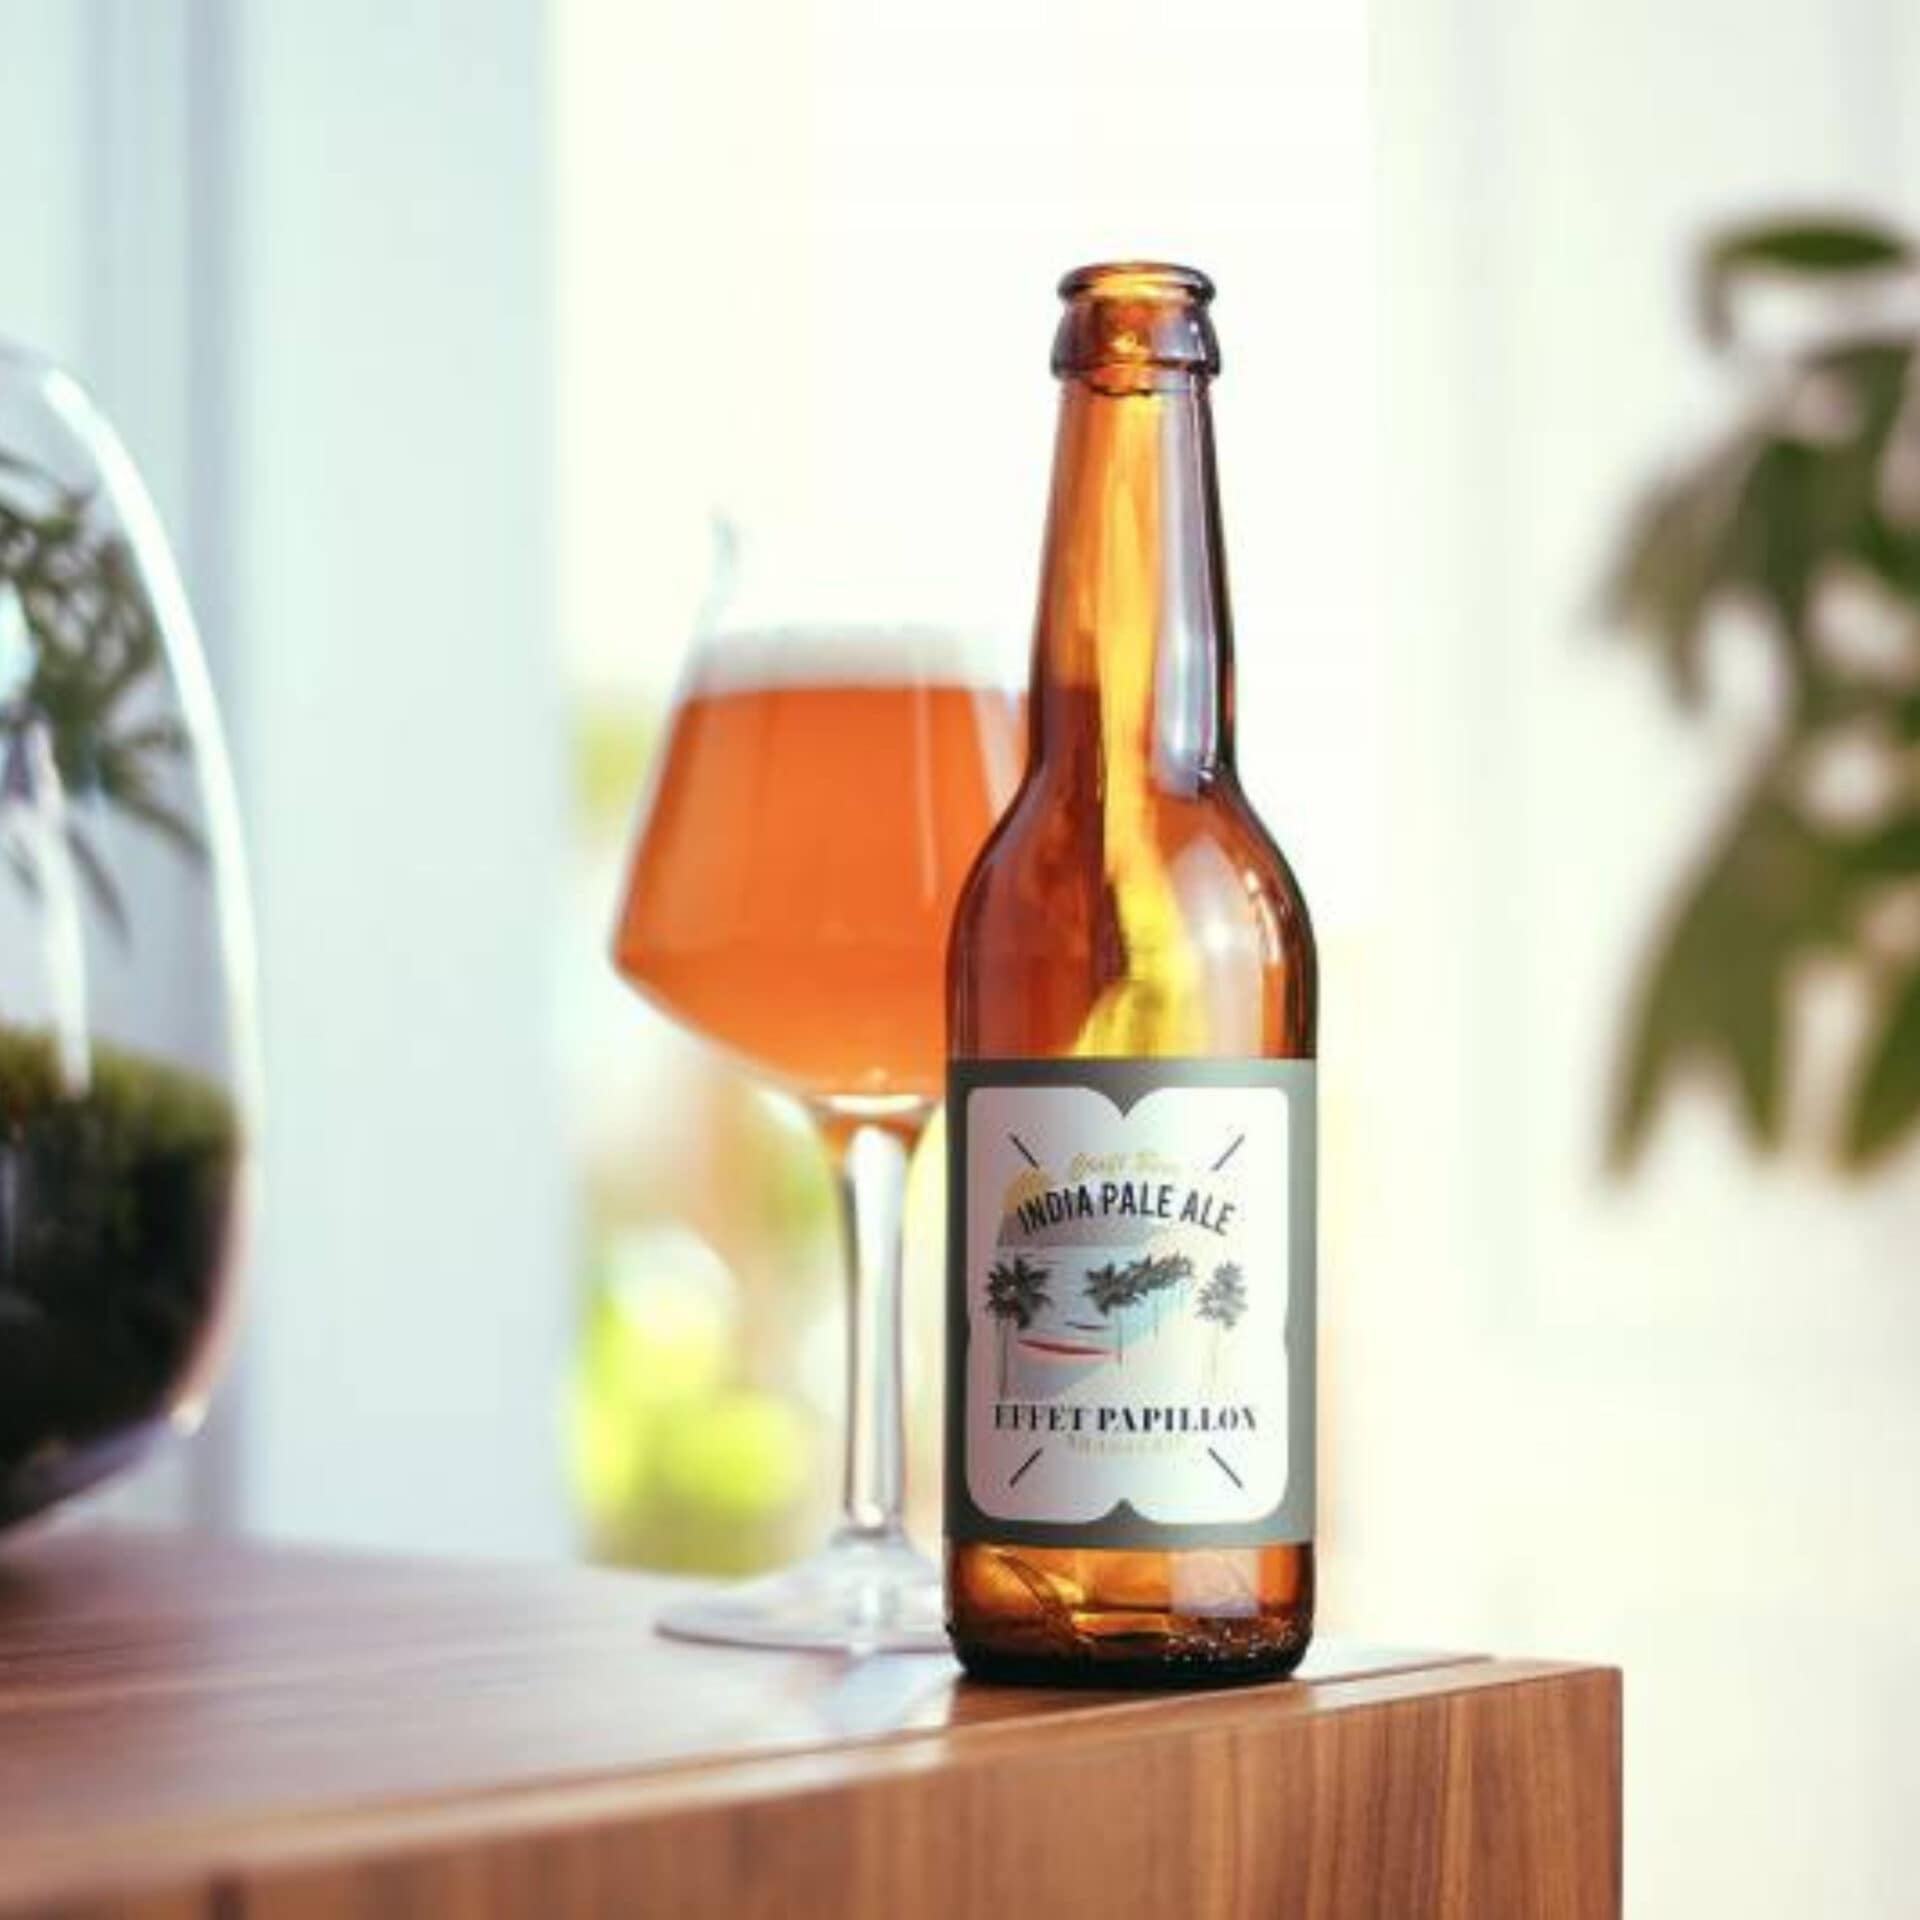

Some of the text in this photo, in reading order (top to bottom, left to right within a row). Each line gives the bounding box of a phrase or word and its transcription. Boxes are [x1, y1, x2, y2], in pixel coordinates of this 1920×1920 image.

[1018, 1182, 1236, 1235] INDIA PALE ALE
[993, 1404, 1257, 1431] EFFET PAPILLON
